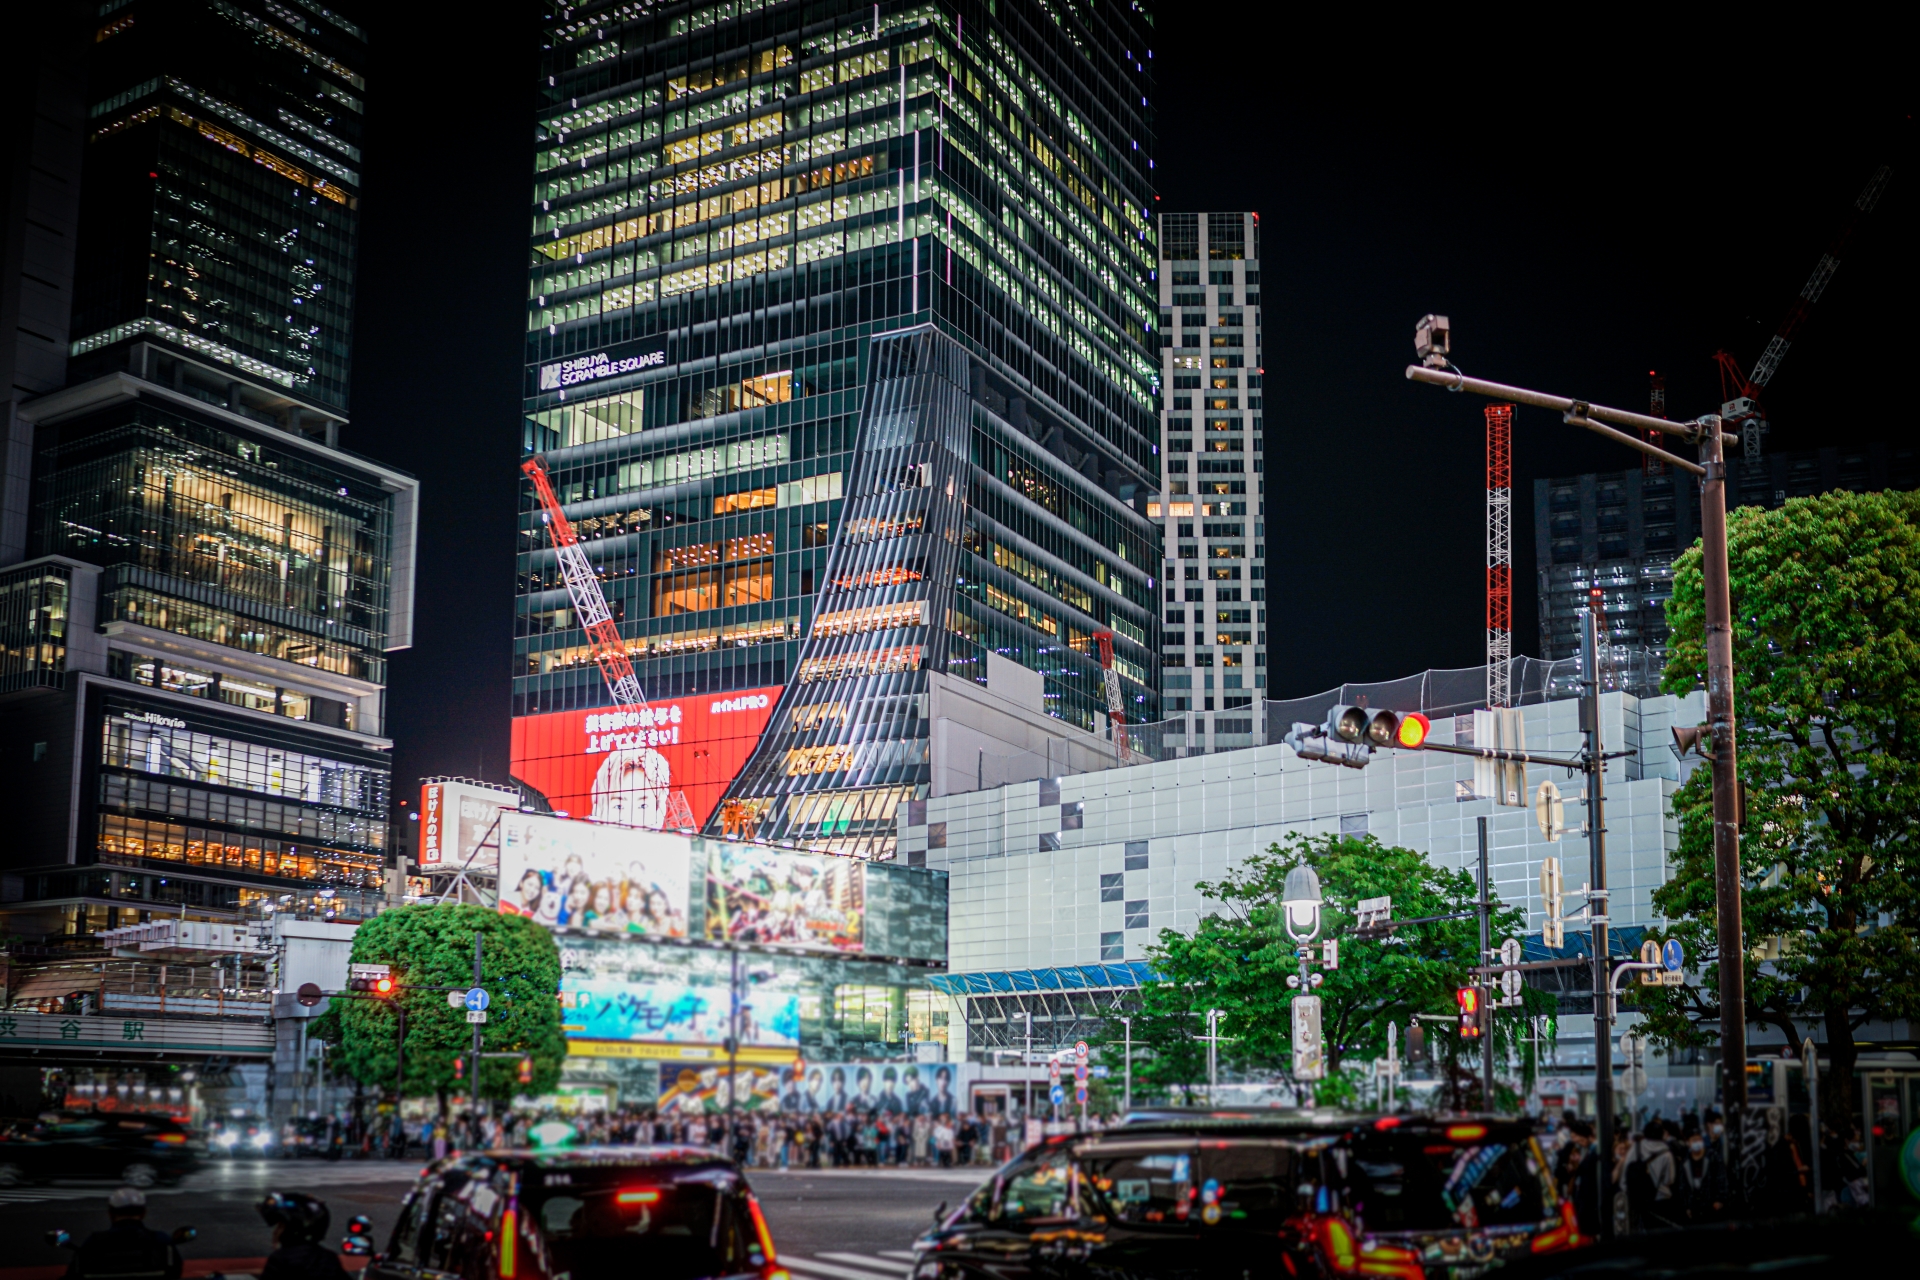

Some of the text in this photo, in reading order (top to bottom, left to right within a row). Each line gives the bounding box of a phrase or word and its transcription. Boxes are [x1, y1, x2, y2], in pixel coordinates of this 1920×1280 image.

[561, 351, 664, 385] SCRAMBLE SQUARE
[562, 353, 609, 372] SHIBUYA
[144, 712, 186, 729] Hikarie
[426, 786, 440, 861] ほけんの窓口
[846, 910, 861, 934] 2
